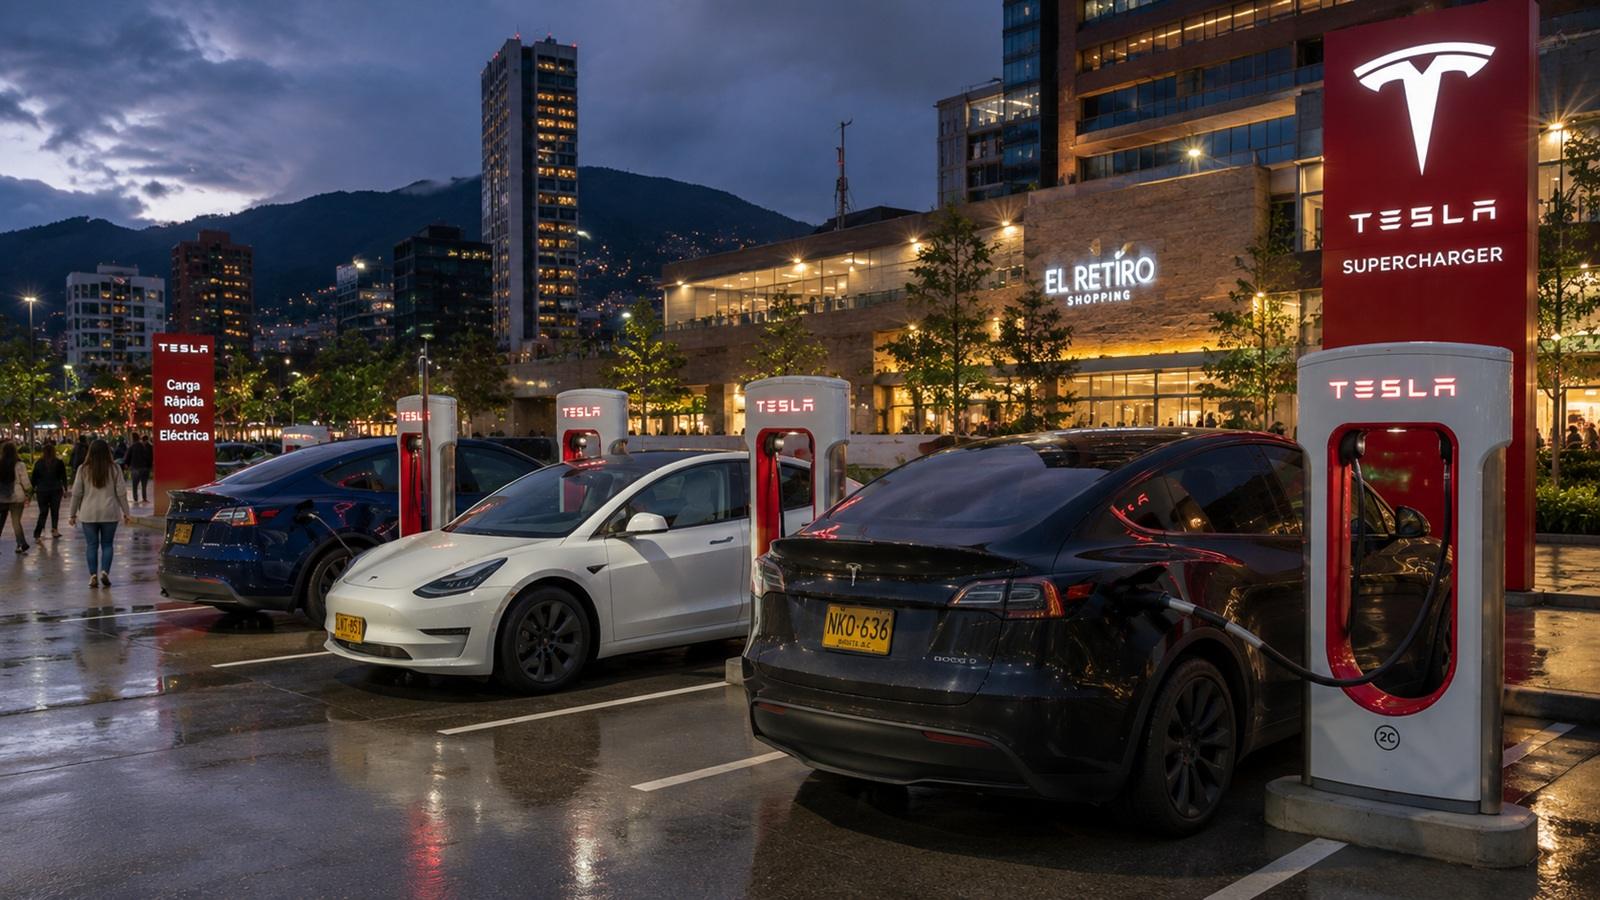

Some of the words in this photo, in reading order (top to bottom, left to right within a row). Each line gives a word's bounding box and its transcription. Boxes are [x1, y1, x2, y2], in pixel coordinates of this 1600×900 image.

[1349, 199, 1496, 233] TESLA
[1342, 246, 1503, 274] SUPERCHARGER
[1045, 268, 1069, 294] EL
[1067, 290, 1131, 306] SHOPPING
[158, 343, 209, 354] TESLA
[166, 379, 200, 393] Carga
[1328, 377, 1456, 399] TESLA
[164, 395, 204, 409] Rápida
[756, 398, 814, 413] TESLA
[168, 413, 200, 424] 100%
[562, 406, 600, 418] TESLA
[160, 429, 209, 441] Eléctrica
[1379, 731, 1395, 743] 2C
